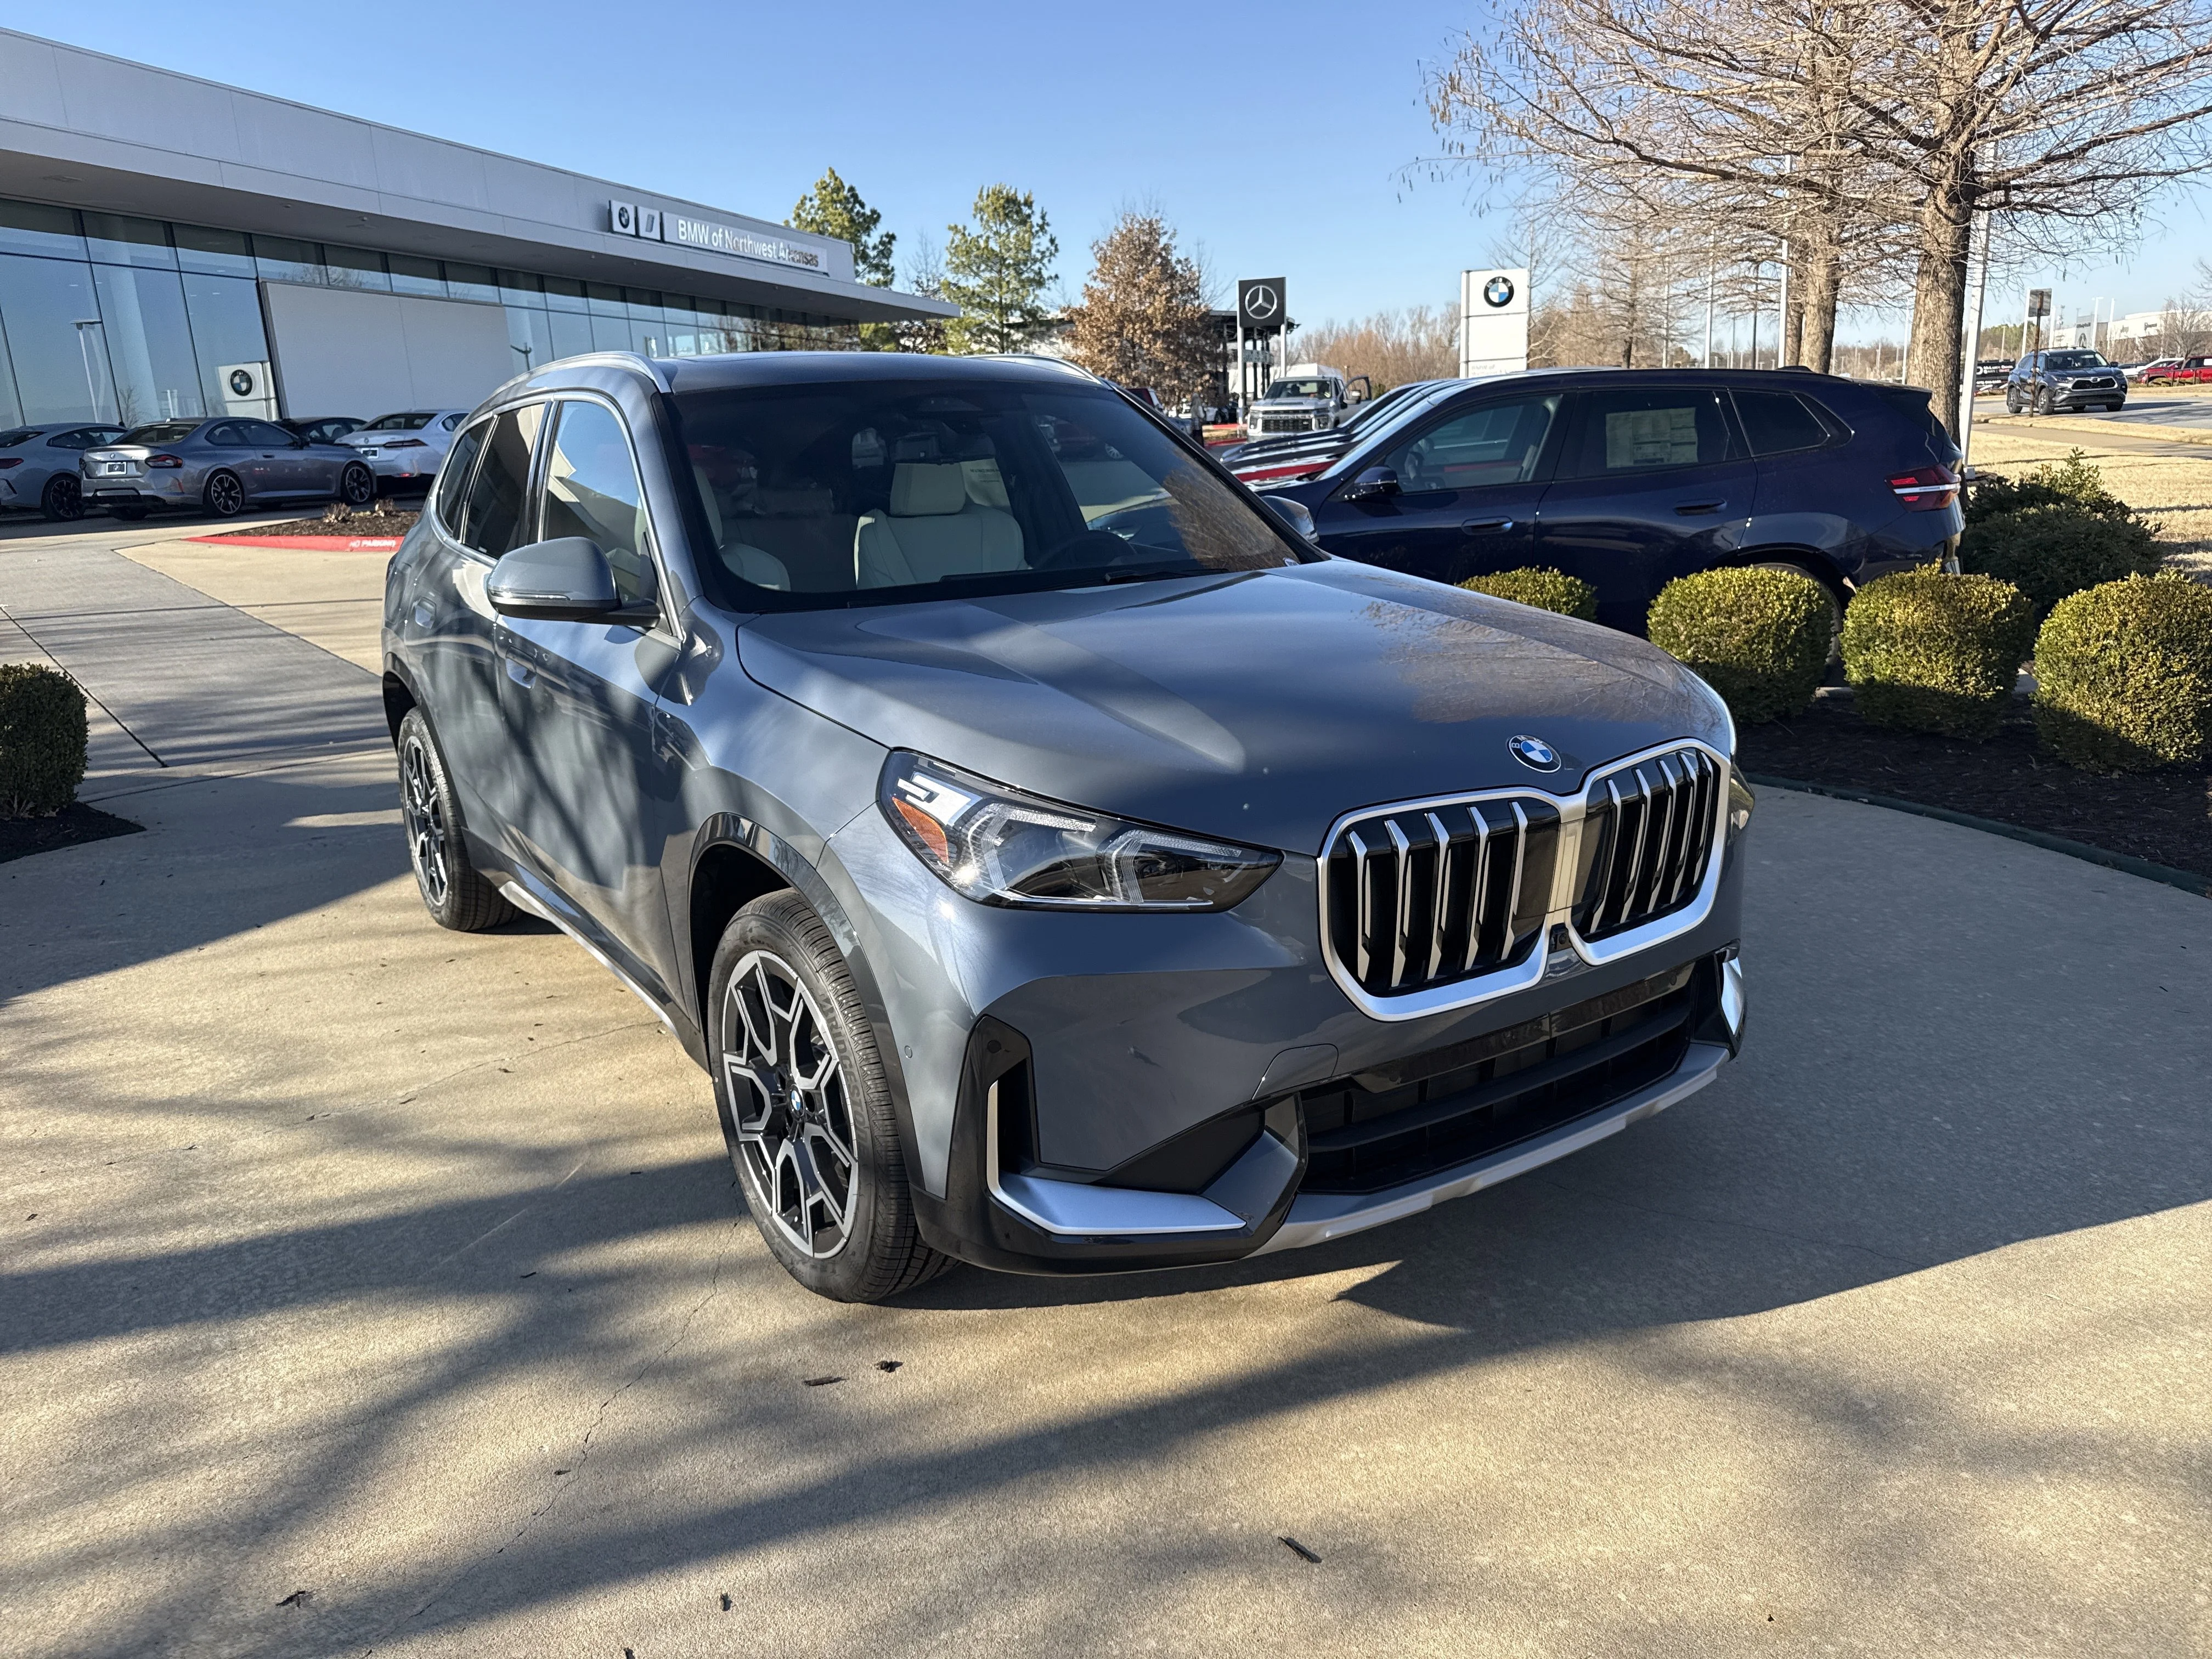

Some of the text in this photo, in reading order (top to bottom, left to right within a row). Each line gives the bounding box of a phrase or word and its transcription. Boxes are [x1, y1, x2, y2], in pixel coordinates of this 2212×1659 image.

[678, 219, 709, 245] BMW
[712, 228, 723, 247] of
[725, 229, 777, 259] Northwest
